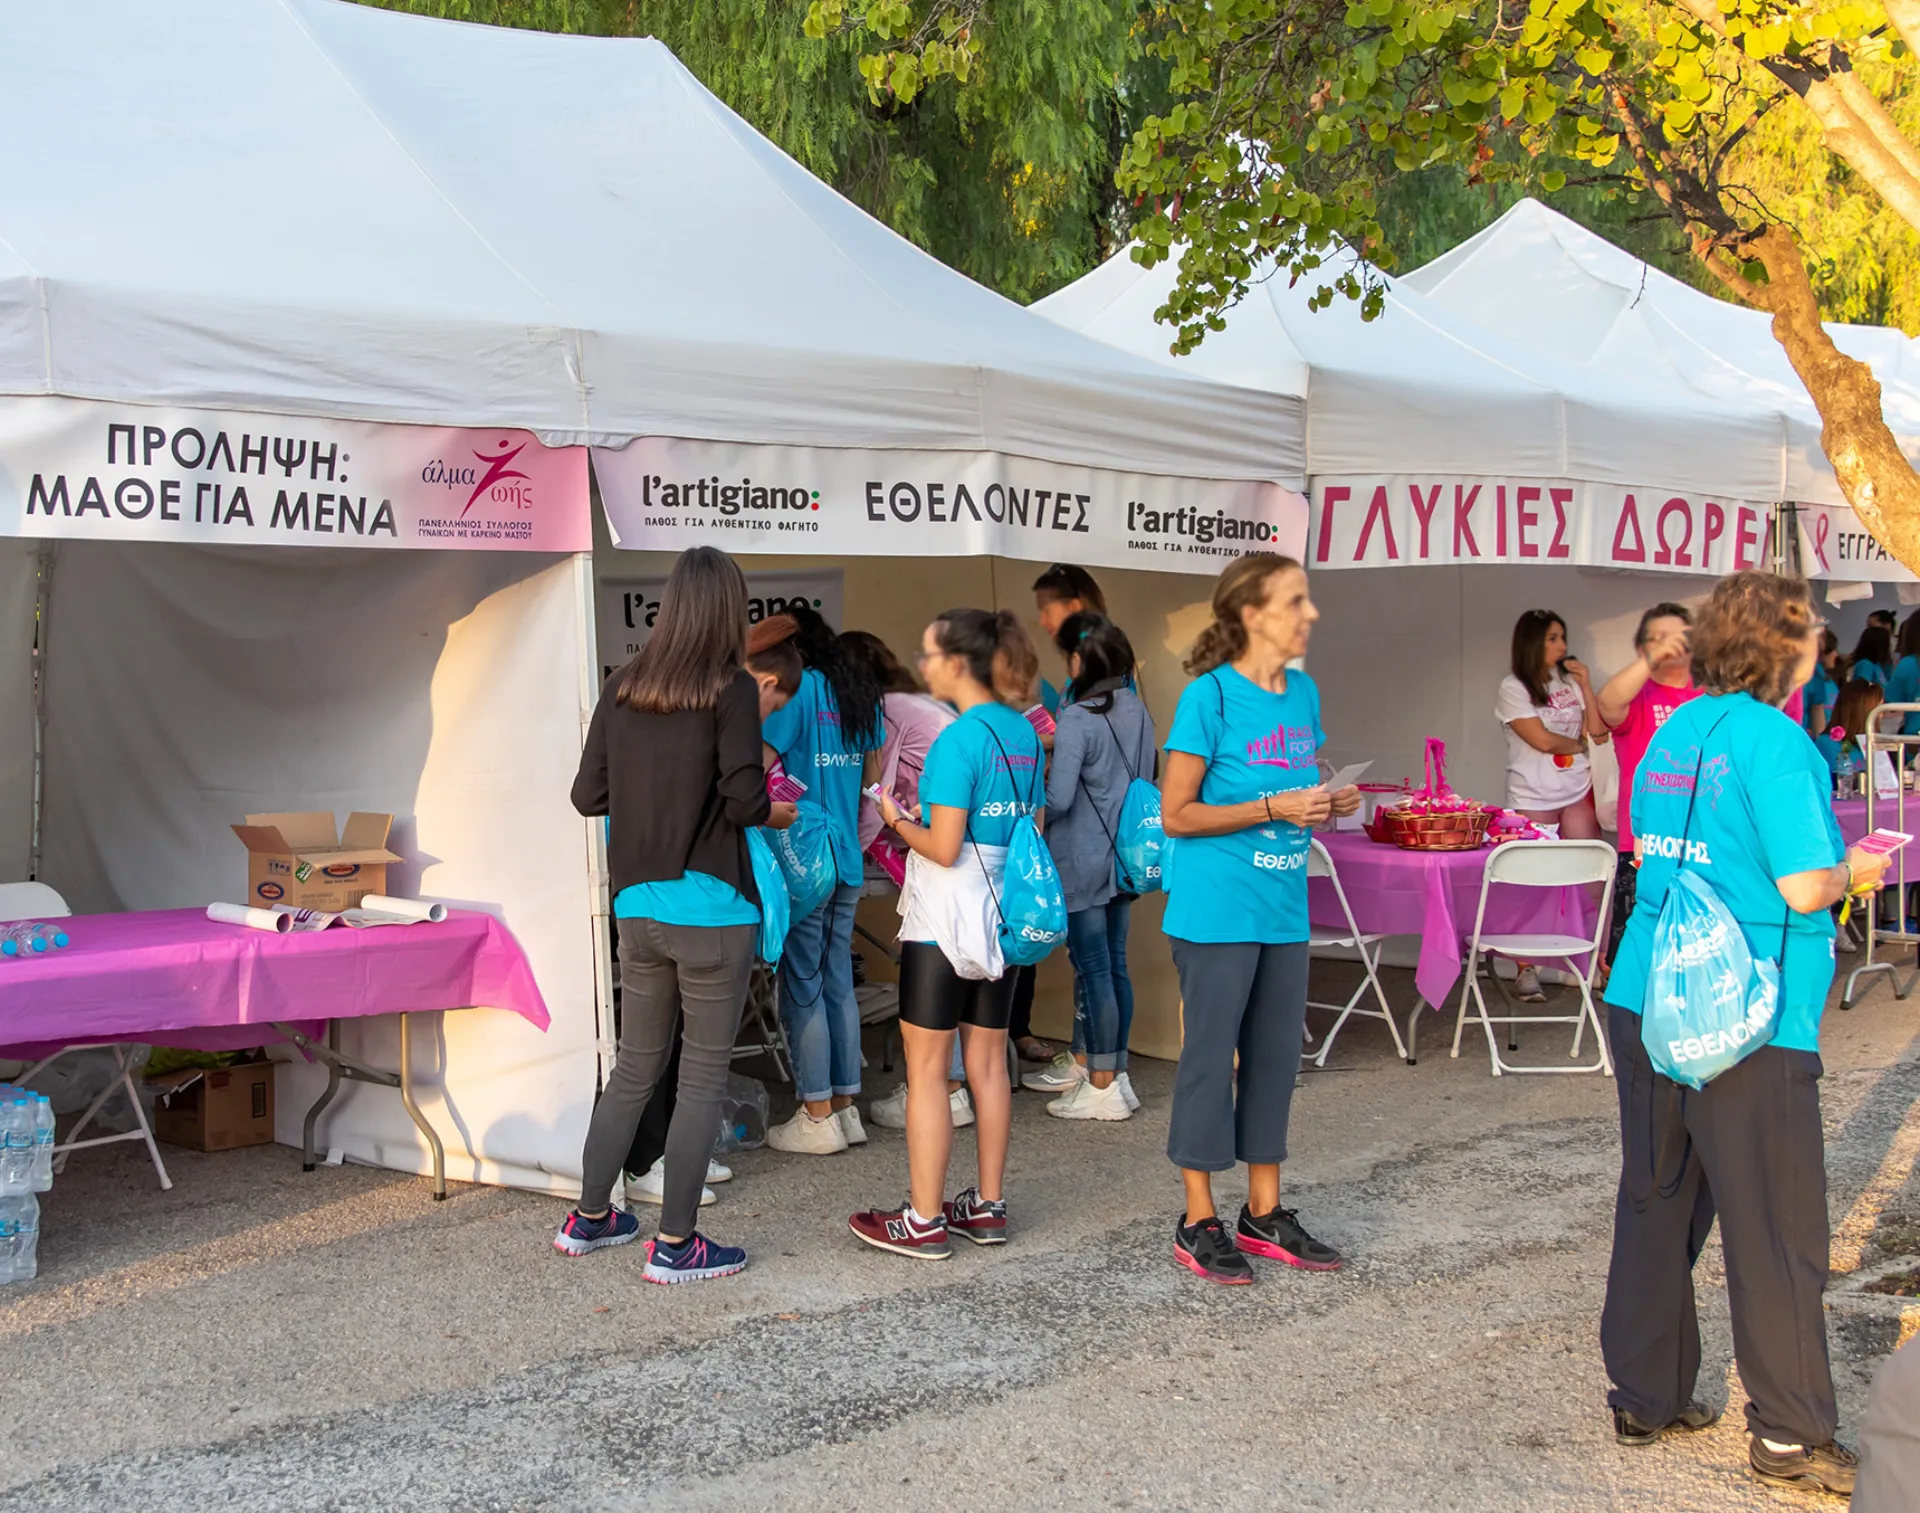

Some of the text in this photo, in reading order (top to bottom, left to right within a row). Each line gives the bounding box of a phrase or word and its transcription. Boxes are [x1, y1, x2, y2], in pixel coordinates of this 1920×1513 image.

[108, 422, 350, 484] ΠΡΟΛΗΨΗ:
[422, 460, 476, 489] άλμα
[26, 474, 399, 538] ΜΑΘΕ ΓΙΑ ΜΕΝΑ
[865, 481, 1091, 534] ΕΘΕΛΟΝΤΕΣ
[418, 519, 532, 530] ΠΑΝΕΛΛΗΝΙΟΣ ΣΥΛΛΟΓΟΣ
[418, 528, 533, 540] ΓΥΝΑΙΚΩΝ ΜΕ ΚΑΡΚΙΝΟ ΜΑΣΤΟΥ
[644, 516, 819, 532] ΠΑΘΟΣ ΓΙΑ ΑΥΘΕΝΤΙΚΟ ΦΑΓΗΤΟ
[1316, 483, 1574, 563] ΓΛΥΚΙΕΣ
[1128, 540, 1158, 551] ΠΑΘΟΣ
[1164, 542, 1183, 553] ΓΙΑ
[1188, 545, 1240, 557] ΑΥΘΕΝΤΙΚΟ
[1838, 532, 1896, 561] ΕΓΓΡΑ
[1253, 848, 1309, 871] ΕΘΕΛΟΝ
